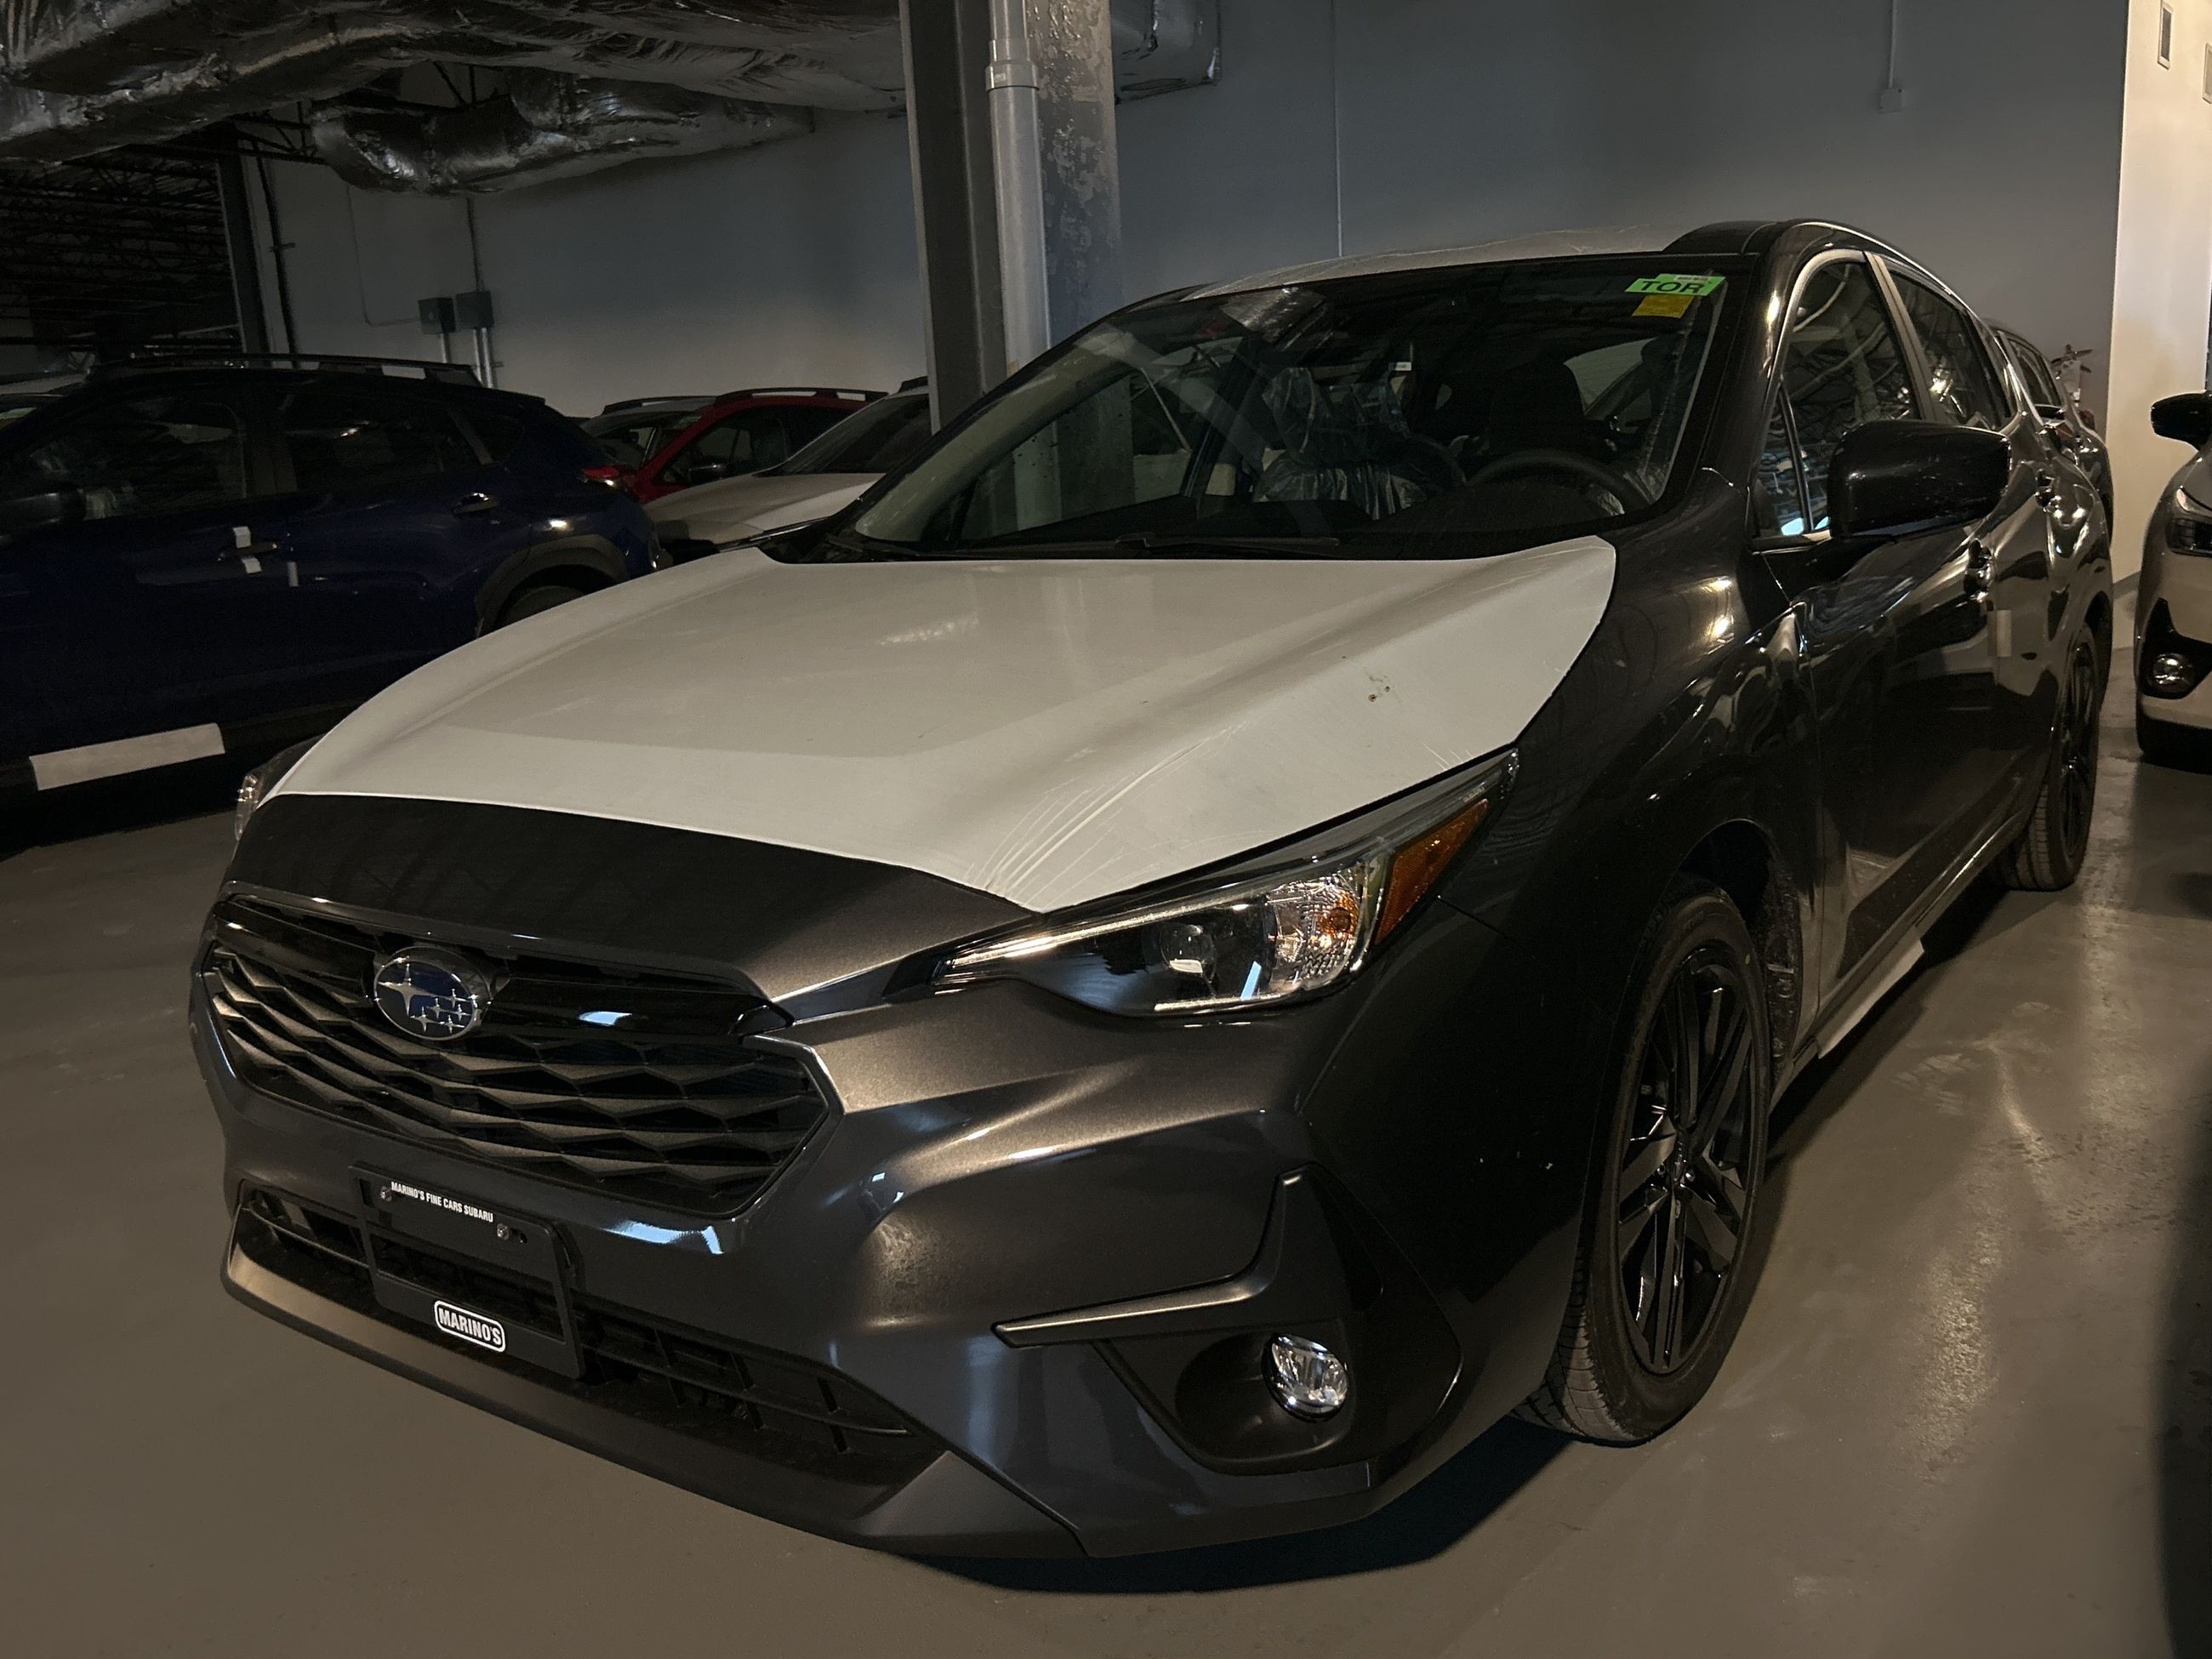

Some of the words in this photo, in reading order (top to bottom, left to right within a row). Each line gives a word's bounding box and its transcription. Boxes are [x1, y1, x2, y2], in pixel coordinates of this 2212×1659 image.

[1641, 281, 1704, 294] TOR
[391, 1182, 425, 1200] MARINO'S
[425, 1192, 442, 1206] FINE
[443, 1198, 462, 1213] CARS
[464, 1205, 493, 1223] SUBARU
[438, 1308, 502, 1345] MARINO'S
